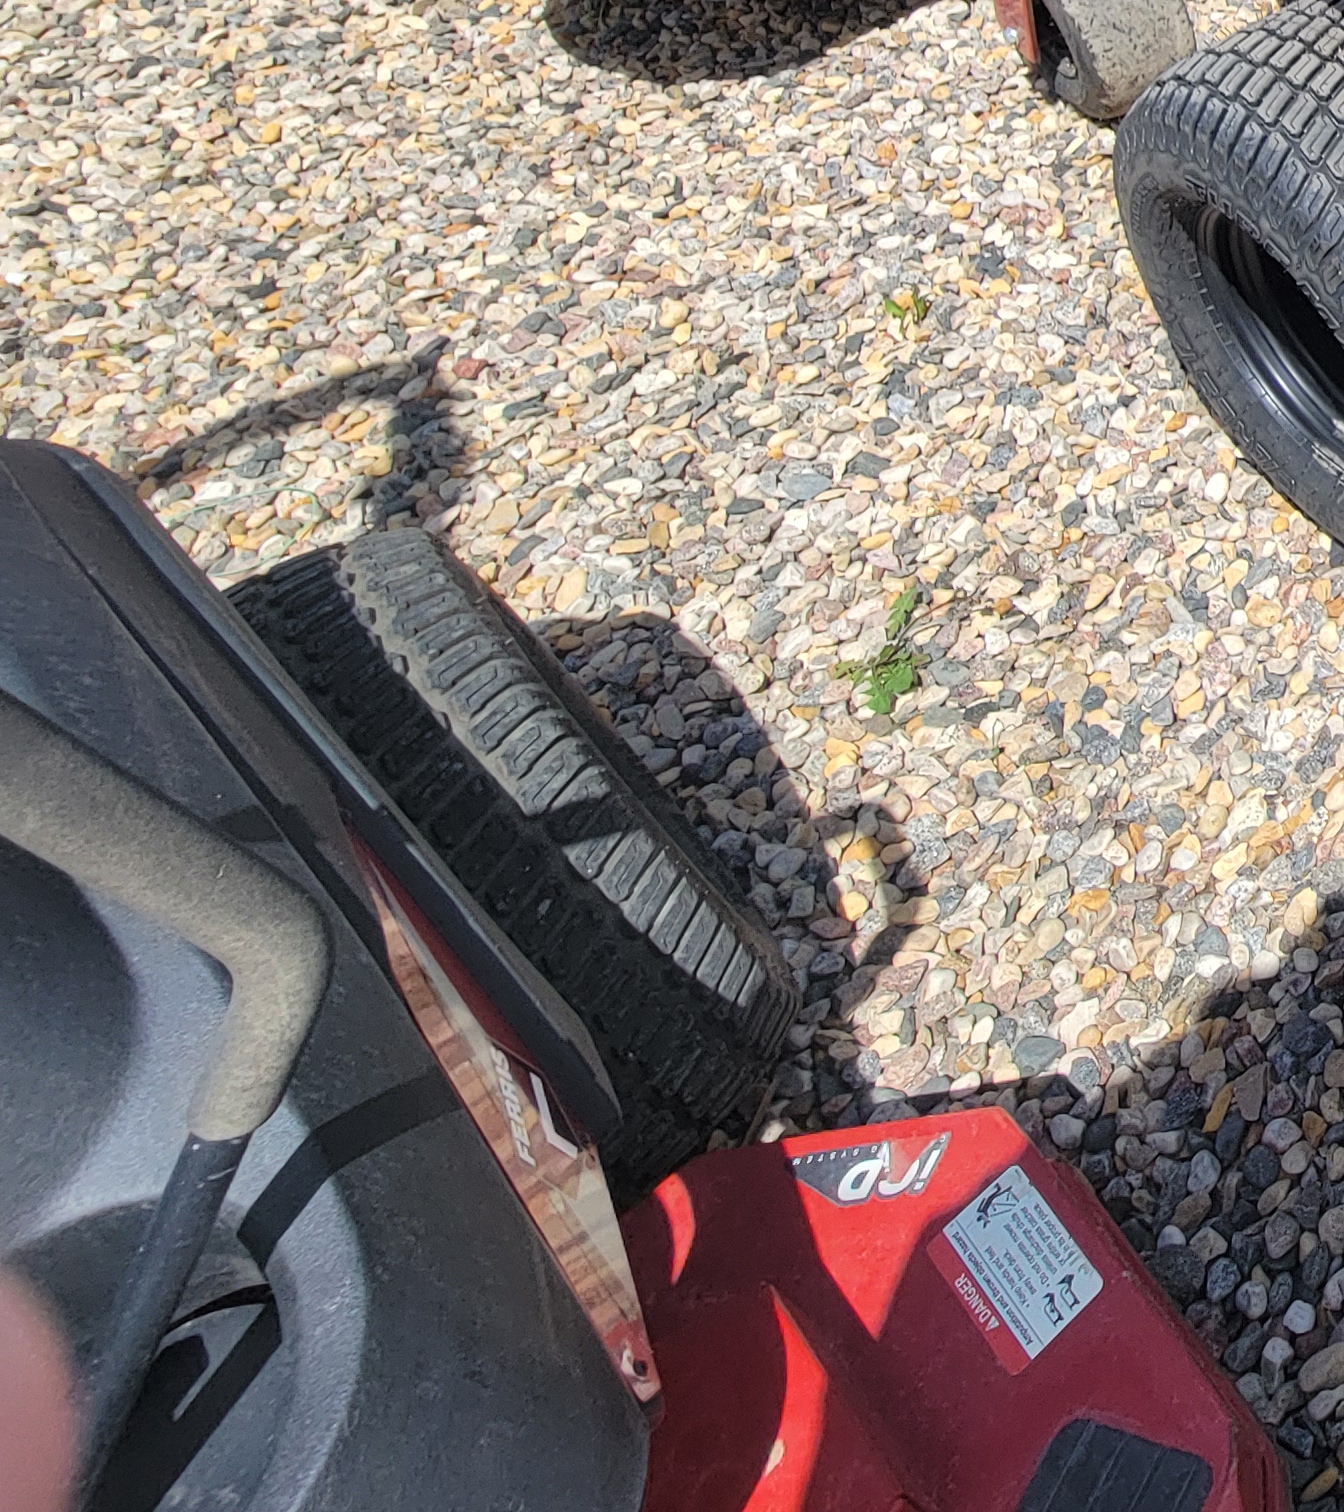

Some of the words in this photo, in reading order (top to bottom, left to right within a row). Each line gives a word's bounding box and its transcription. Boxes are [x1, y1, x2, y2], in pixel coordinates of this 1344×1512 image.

[490, 1047, 536, 1167] FERRIS
[1010, 1210, 1026, 1231] chute
[1019, 1204, 1038, 1230] catcher
[1043, 1216, 1062, 1241] proper
[951, 1229, 971, 1255] hazard
[1003, 1221, 1020, 1244] mower
[1021, 1225, 1046, 1258] discharge
[1034, 1223, 1051, 1245] grass
[983, 1245, 997, 1261] feet
[1016, 1238, 1037, 1266] operate
[1044, 1240, 1060, 1261] entire
[966, 1249, 987, 1277] objects
[992, 1256, 1005, 1272] and
[1012, 1263, 1026, 1282] from
[1031, 1261, 1043, 1276] not
[1039, 1253, 1058, 1277] unless
[981, 1272, 1000, 1299] thrown
[1000, 1267, 1018, 1291] hands
[1022, 1276, 1038, 1297] away
[1038, 1271, 1049, 1285] Do
[954, 1271, 992, 1324] DANGER
[995, 1293, 1009, 1311] and
[1013, 1284, 1030, 1306] Keep
[1004, 1305, 1035, 1348] Amputation
